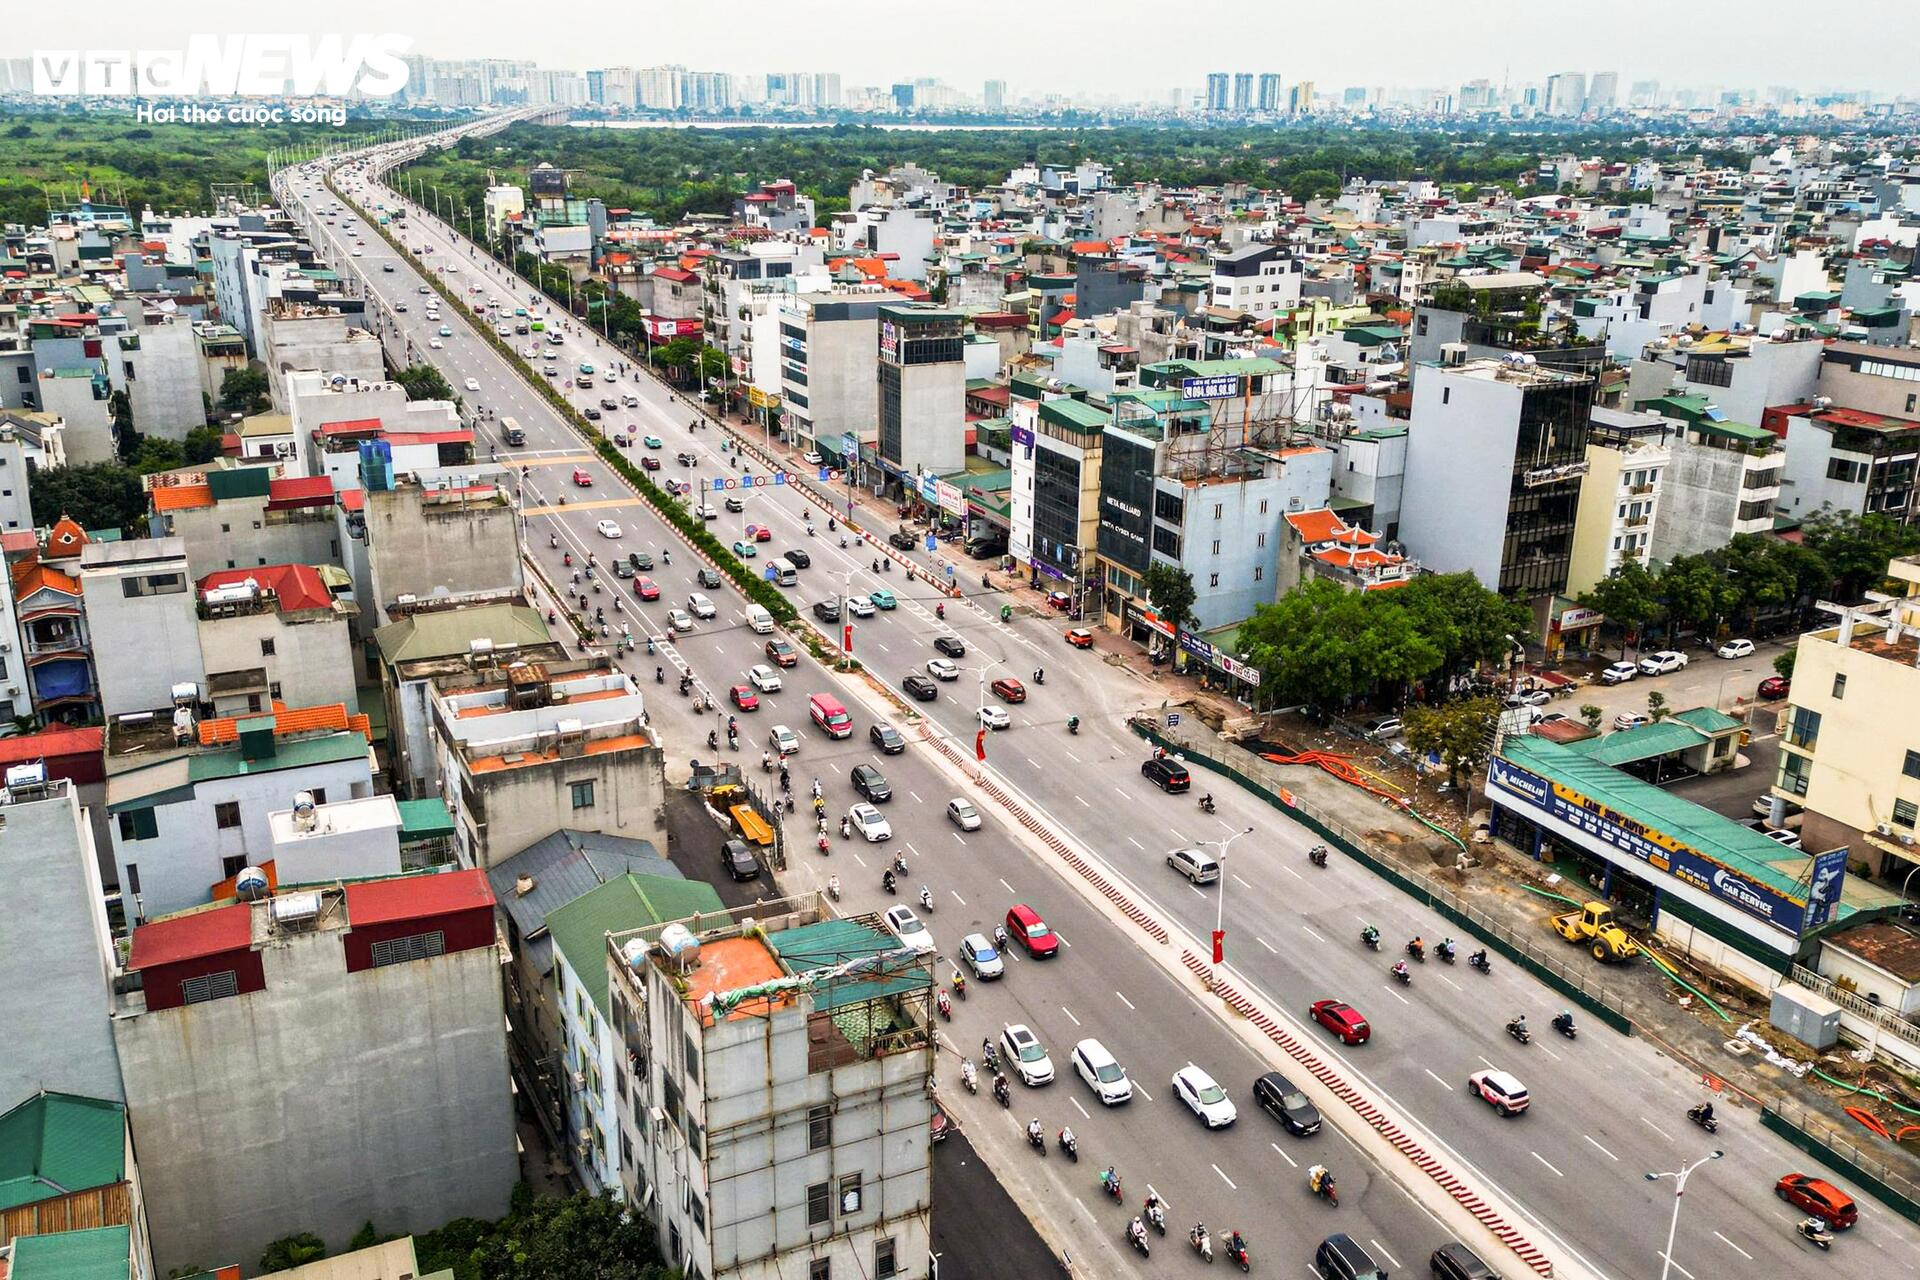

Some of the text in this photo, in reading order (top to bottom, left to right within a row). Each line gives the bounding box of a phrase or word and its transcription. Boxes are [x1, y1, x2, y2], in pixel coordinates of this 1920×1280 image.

[1509, 775, 1545, 798] MICHELIN
[1722, 881, 1773, 915] CAR SERVICE
